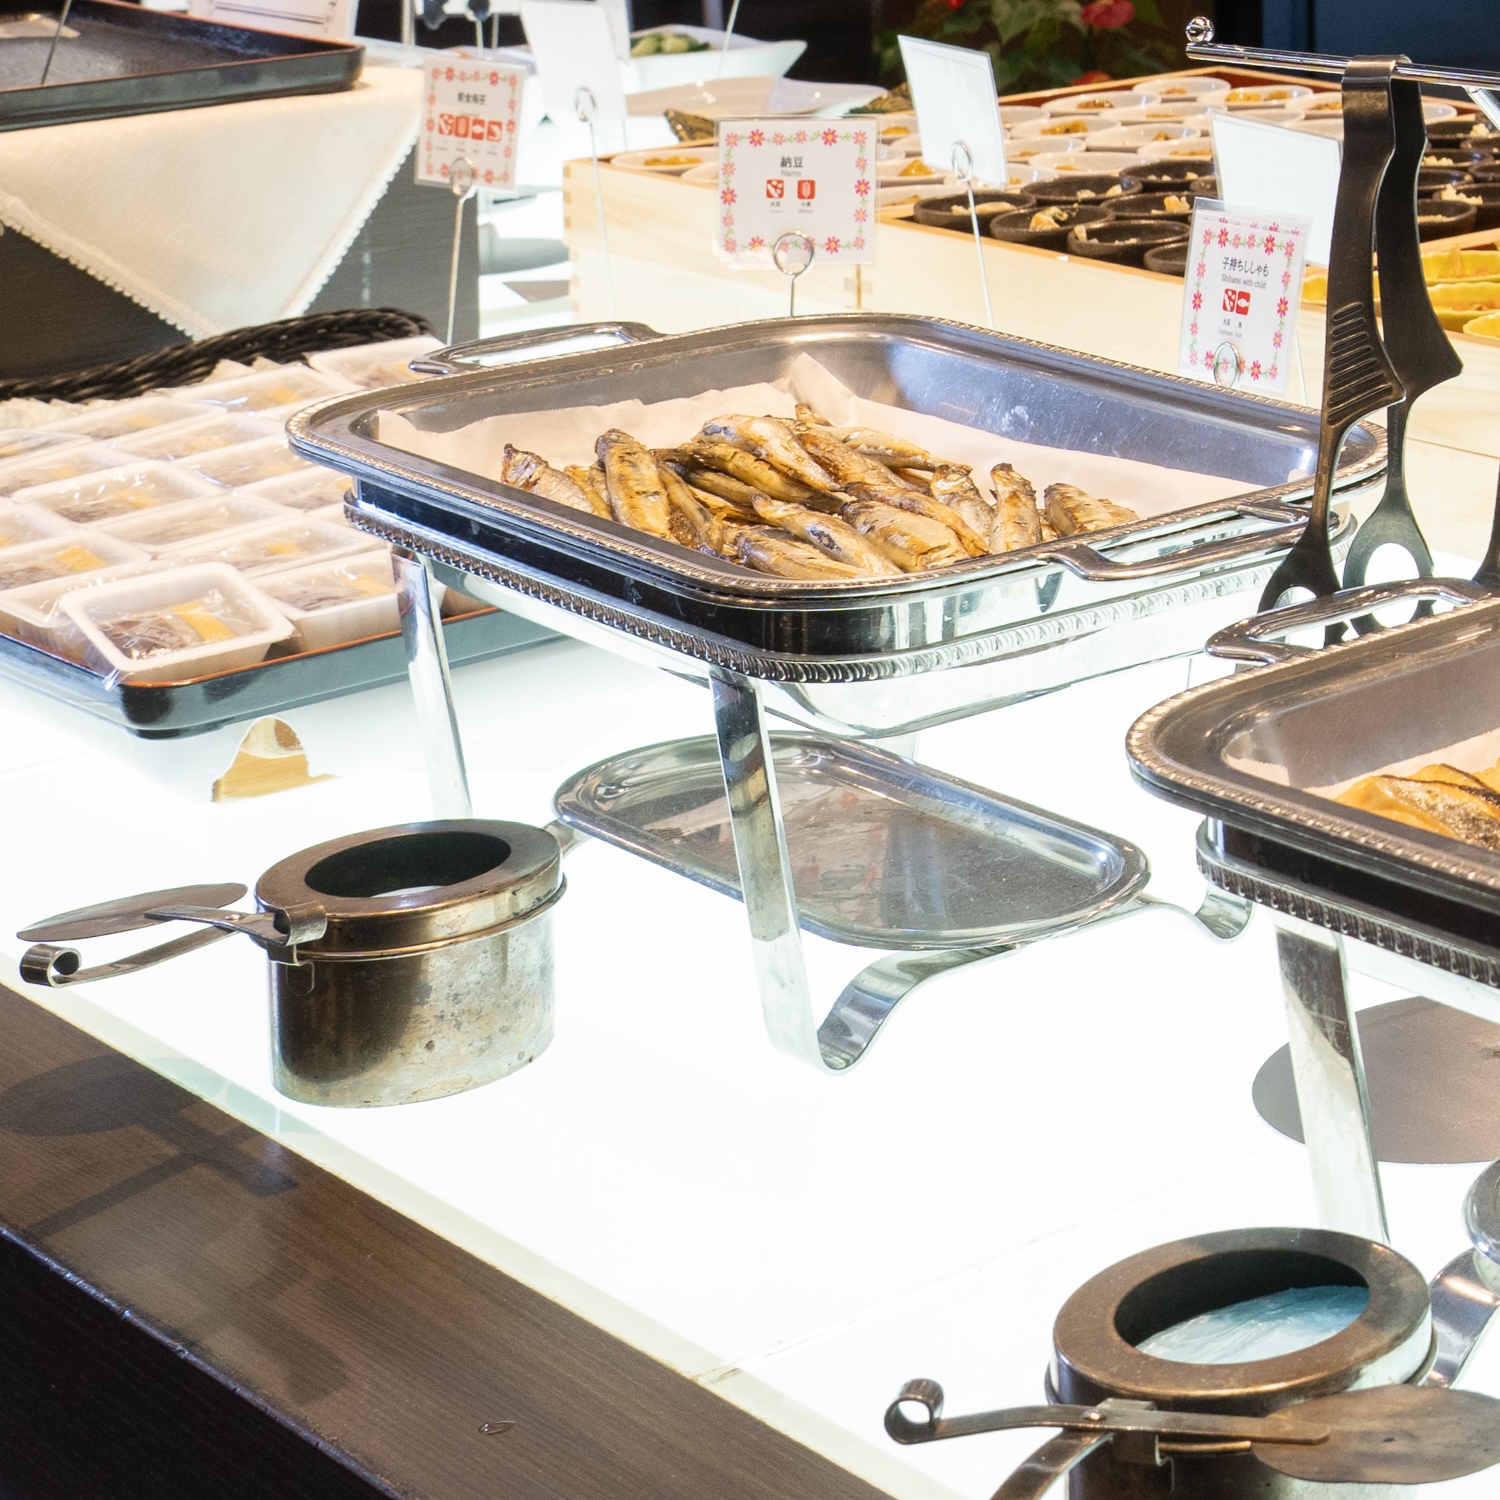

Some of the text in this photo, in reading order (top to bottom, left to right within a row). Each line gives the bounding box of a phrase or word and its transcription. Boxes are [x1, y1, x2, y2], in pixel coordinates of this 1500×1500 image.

[780, 156, 804, 169] 納豆
[1222, 257, 1269, 277] 子持ちししゃも
